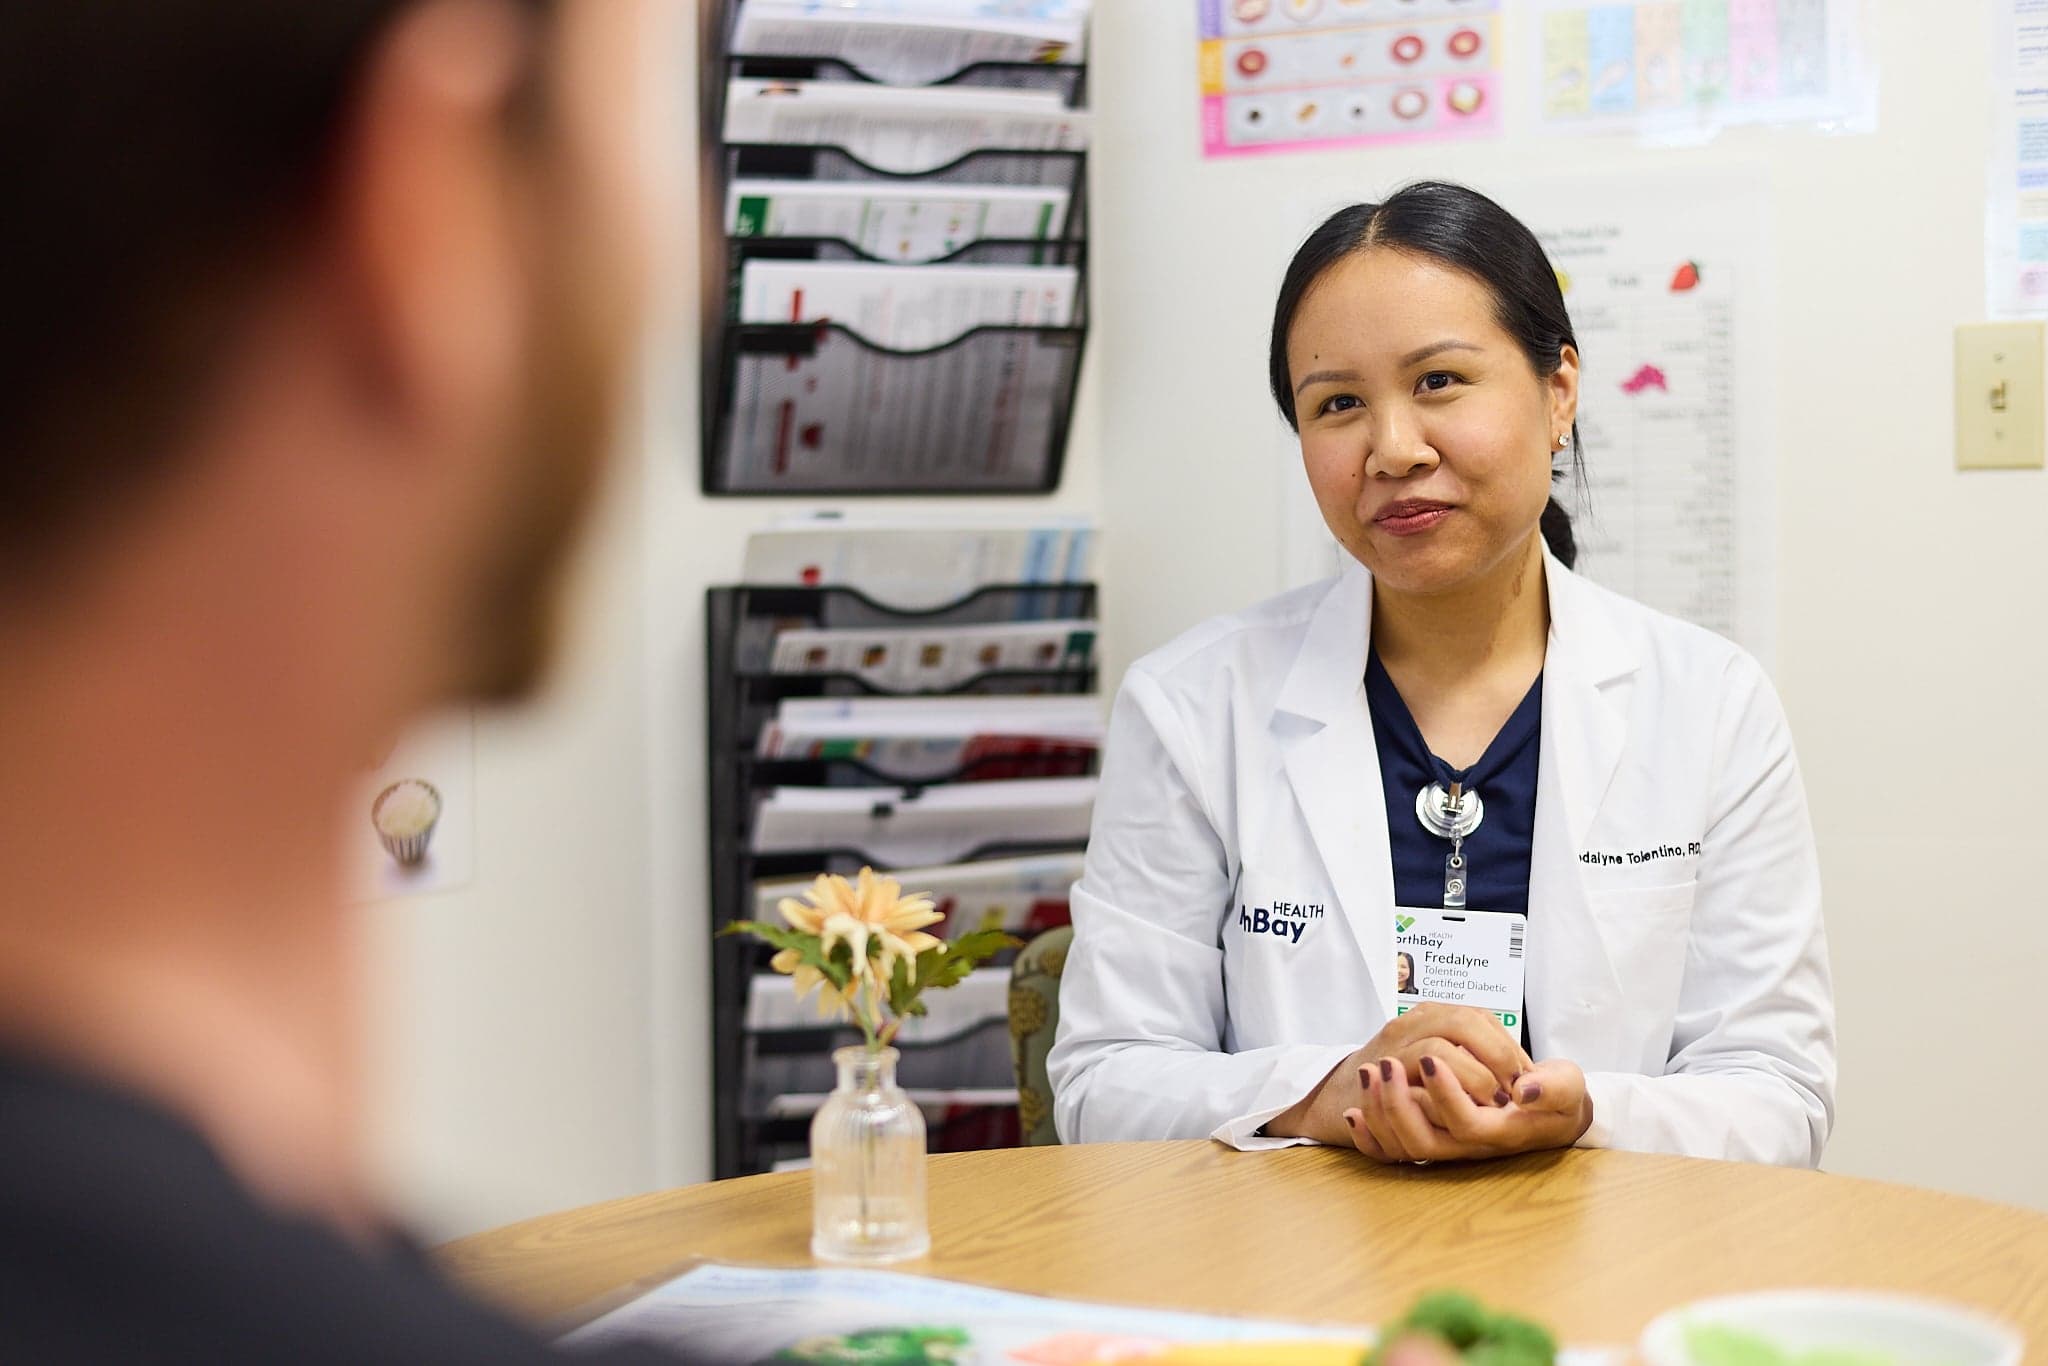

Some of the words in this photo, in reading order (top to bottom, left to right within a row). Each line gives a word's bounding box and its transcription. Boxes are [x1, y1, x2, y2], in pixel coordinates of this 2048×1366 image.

[1579, 851, 1623, 866] dalyne
[1626, 844, 1686, 865] Tolentino,
[1273, 900, 1324, 919] HEALTH
[1396, 934, 1443, 949] orthBay
[1428, 932, 1453, 940] HEALTH
[1425, 951, 1489, 968] Fredalyne
[1424, 966, 1469, 978] Tolentino
[1422, 977, 1465, 989] Certified
[1467, 980, 1507, 993] Diabetic
[1422, 989, 1465, 1001] Educator
